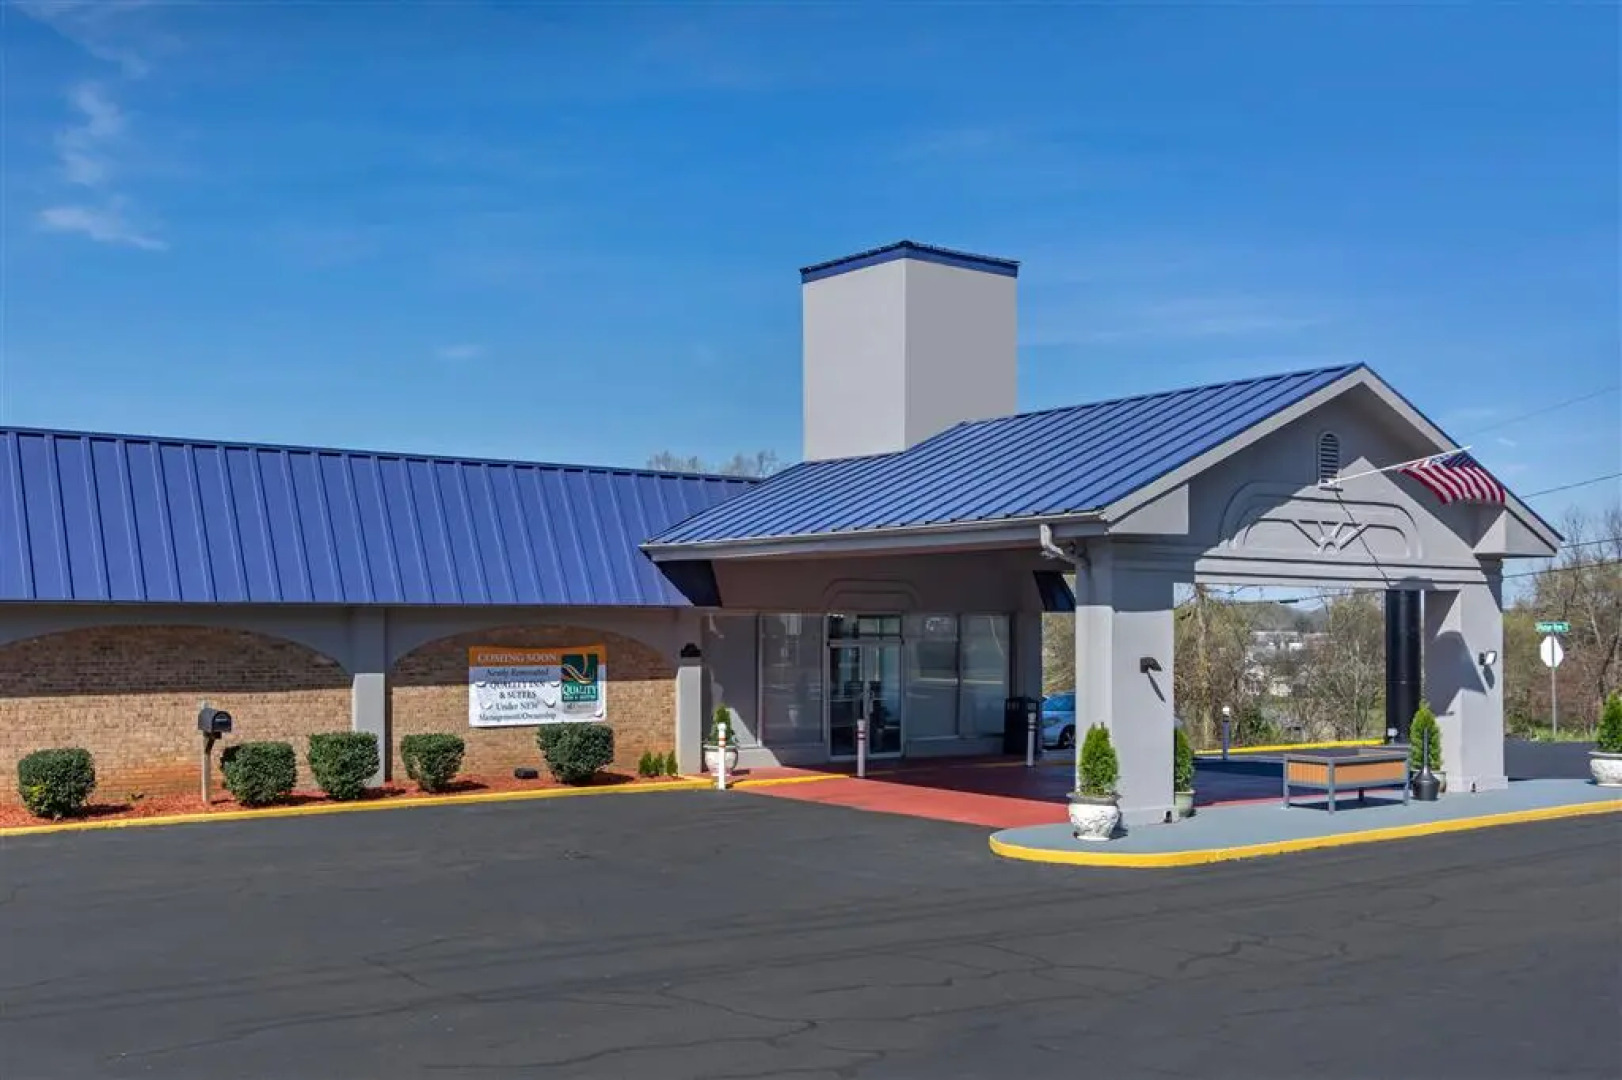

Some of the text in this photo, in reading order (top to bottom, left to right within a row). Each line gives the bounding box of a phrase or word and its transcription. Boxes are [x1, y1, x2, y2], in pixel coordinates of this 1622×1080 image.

[478, 653, 557, 663] COMING SOON
[489, 680, 546, 690] QUALITY INN
[563, 684, 597, 696] QUALITY
[507, 691, 537, 699] SUITES
[495, 702, 538, 711] Under NEW
